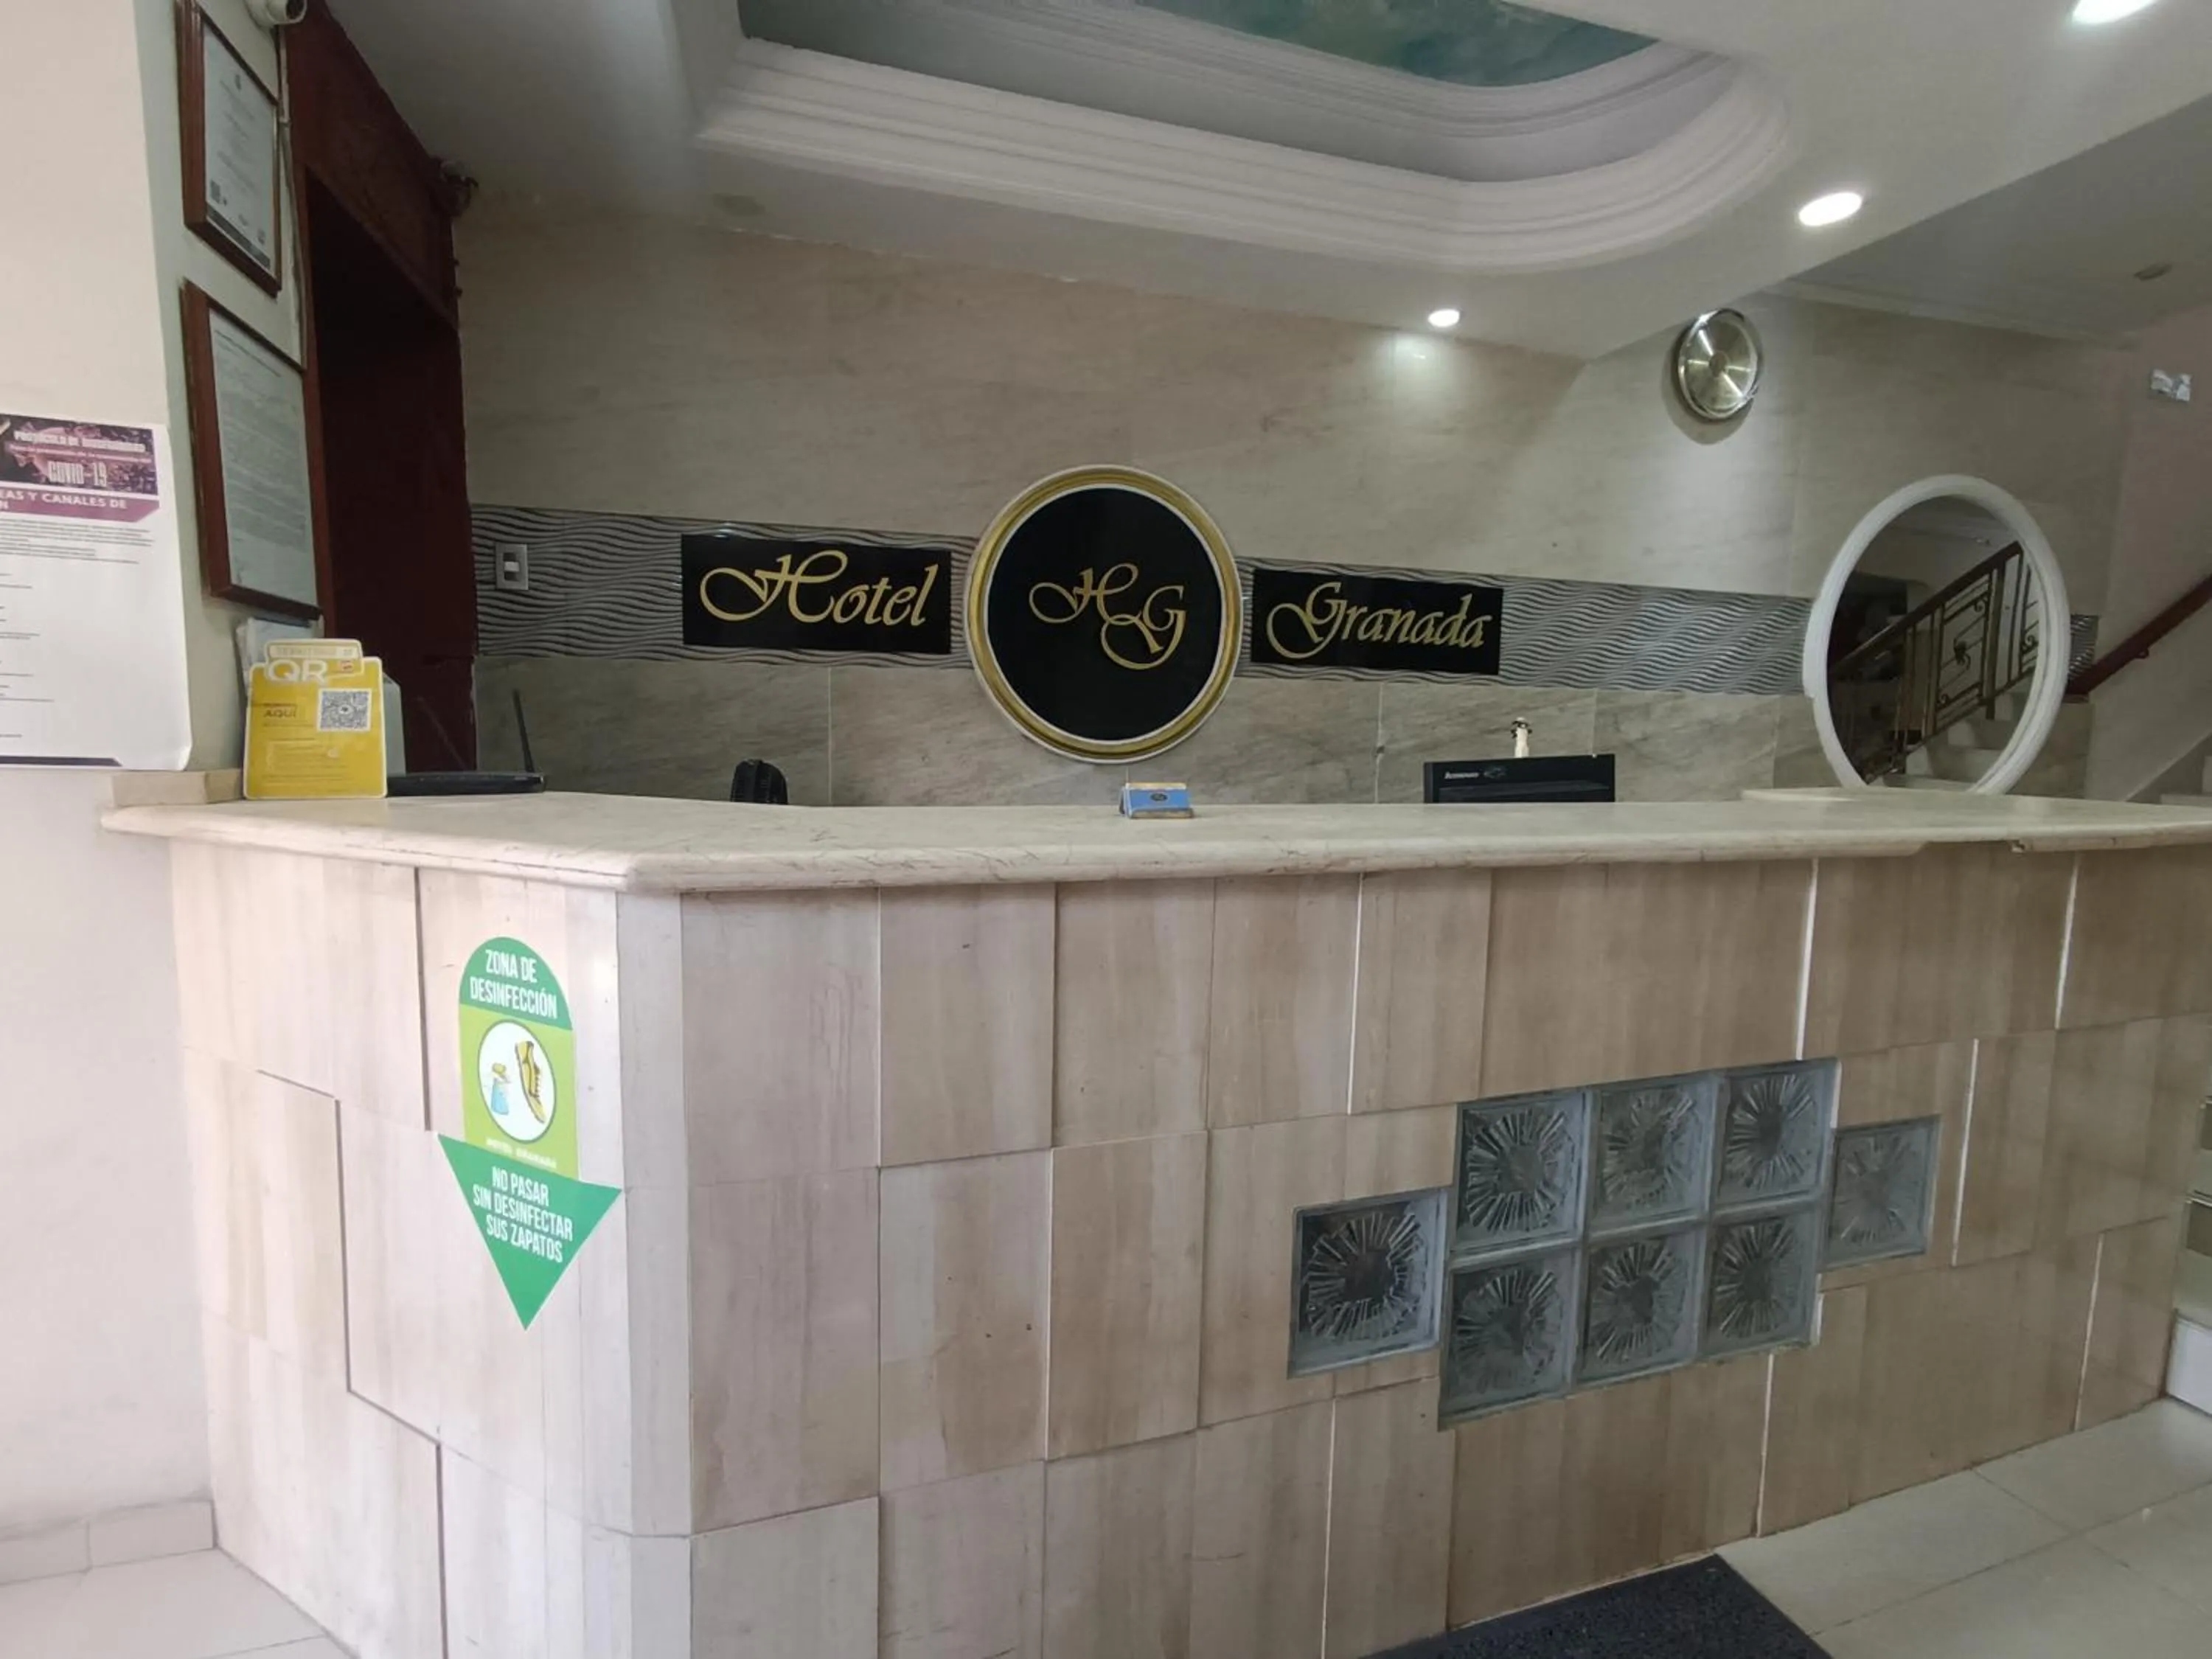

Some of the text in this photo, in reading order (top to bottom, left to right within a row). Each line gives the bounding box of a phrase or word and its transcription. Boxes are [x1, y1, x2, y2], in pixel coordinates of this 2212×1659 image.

[27, 492, 37, 501] Y
[41, 493, 106, 508] CANALES
[109, 499, 128, 509] DE
[700, 549, 939, 626] Hotel
[1267, 581, 1492, 658] Granada
[268, 659, 327, 686] QR
[485, 949, 538, 983] ZONA DE
[470, 976, 558, 1019] DESINFECCIÓN
[492, 1166, 549, 1206] NO PASAR
[473, 1183, 573, 1242] SIN DESINFECTAR
[486, 1214, 563, 1263] SUS ZAPATOS
